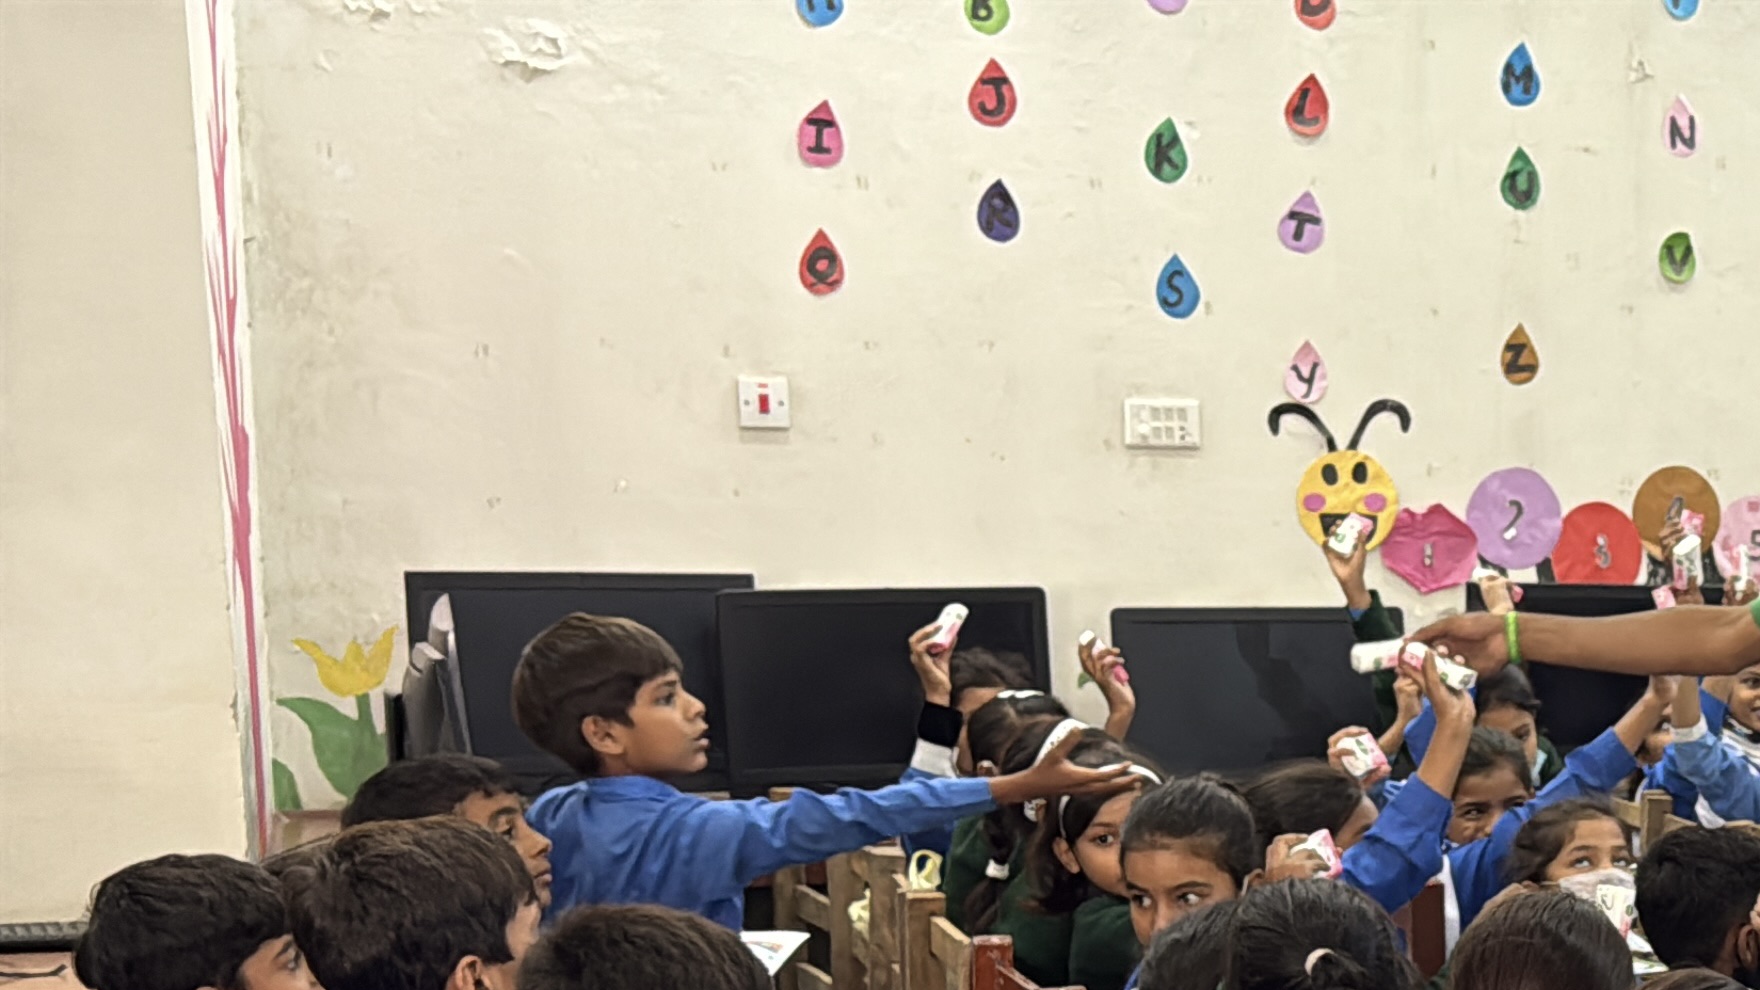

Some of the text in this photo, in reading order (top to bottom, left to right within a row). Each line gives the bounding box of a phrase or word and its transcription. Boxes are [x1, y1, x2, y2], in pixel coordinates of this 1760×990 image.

[978, 77, 1009, 118] J
[1502, 64, 1533, 95] M
[1293, 87, 1320, 126] L
[807, 117, 833, 154] I
[1669, 115, 1696, 151] N
[1155, 132, 1181, 175] K
[1507, 167, 1536, 202] U
[1288, 211, 1322, 242] T
[806, 246, 839, 287] Q
[1665, 244, 1692, 278] V
[1163, 270, 1184, 309] S
[1504, 342, 1536, 375] Z
[1503, 500, 1524, 541] 2
[1595, 533, 1611, 569] 3
